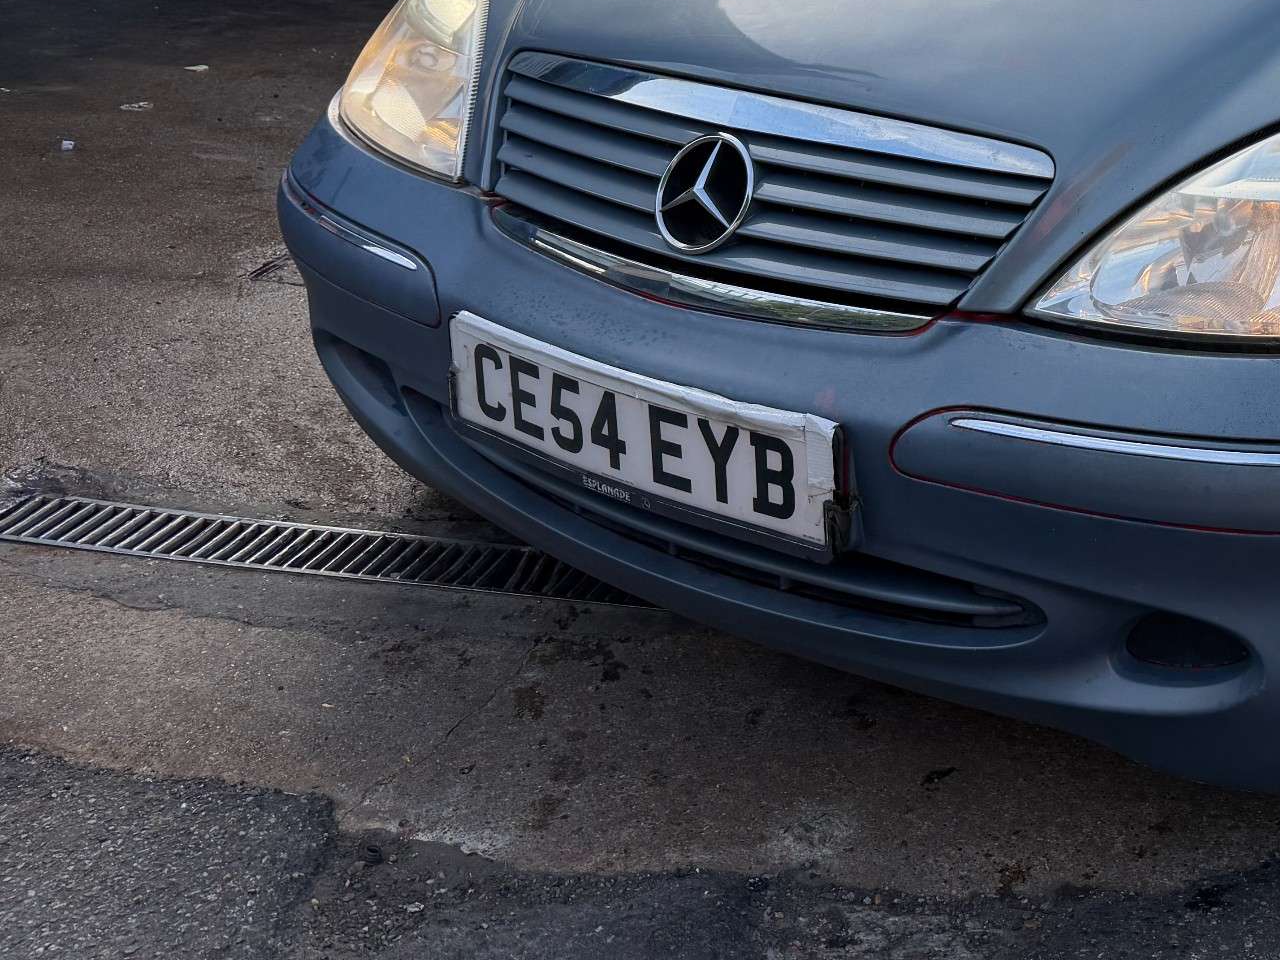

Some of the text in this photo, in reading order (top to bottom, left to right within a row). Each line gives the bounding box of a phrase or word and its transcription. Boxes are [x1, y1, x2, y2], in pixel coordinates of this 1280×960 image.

[474, 342, 796, 520] CE54 EYB
[582, 473, 632, 503] ESPLANADE
